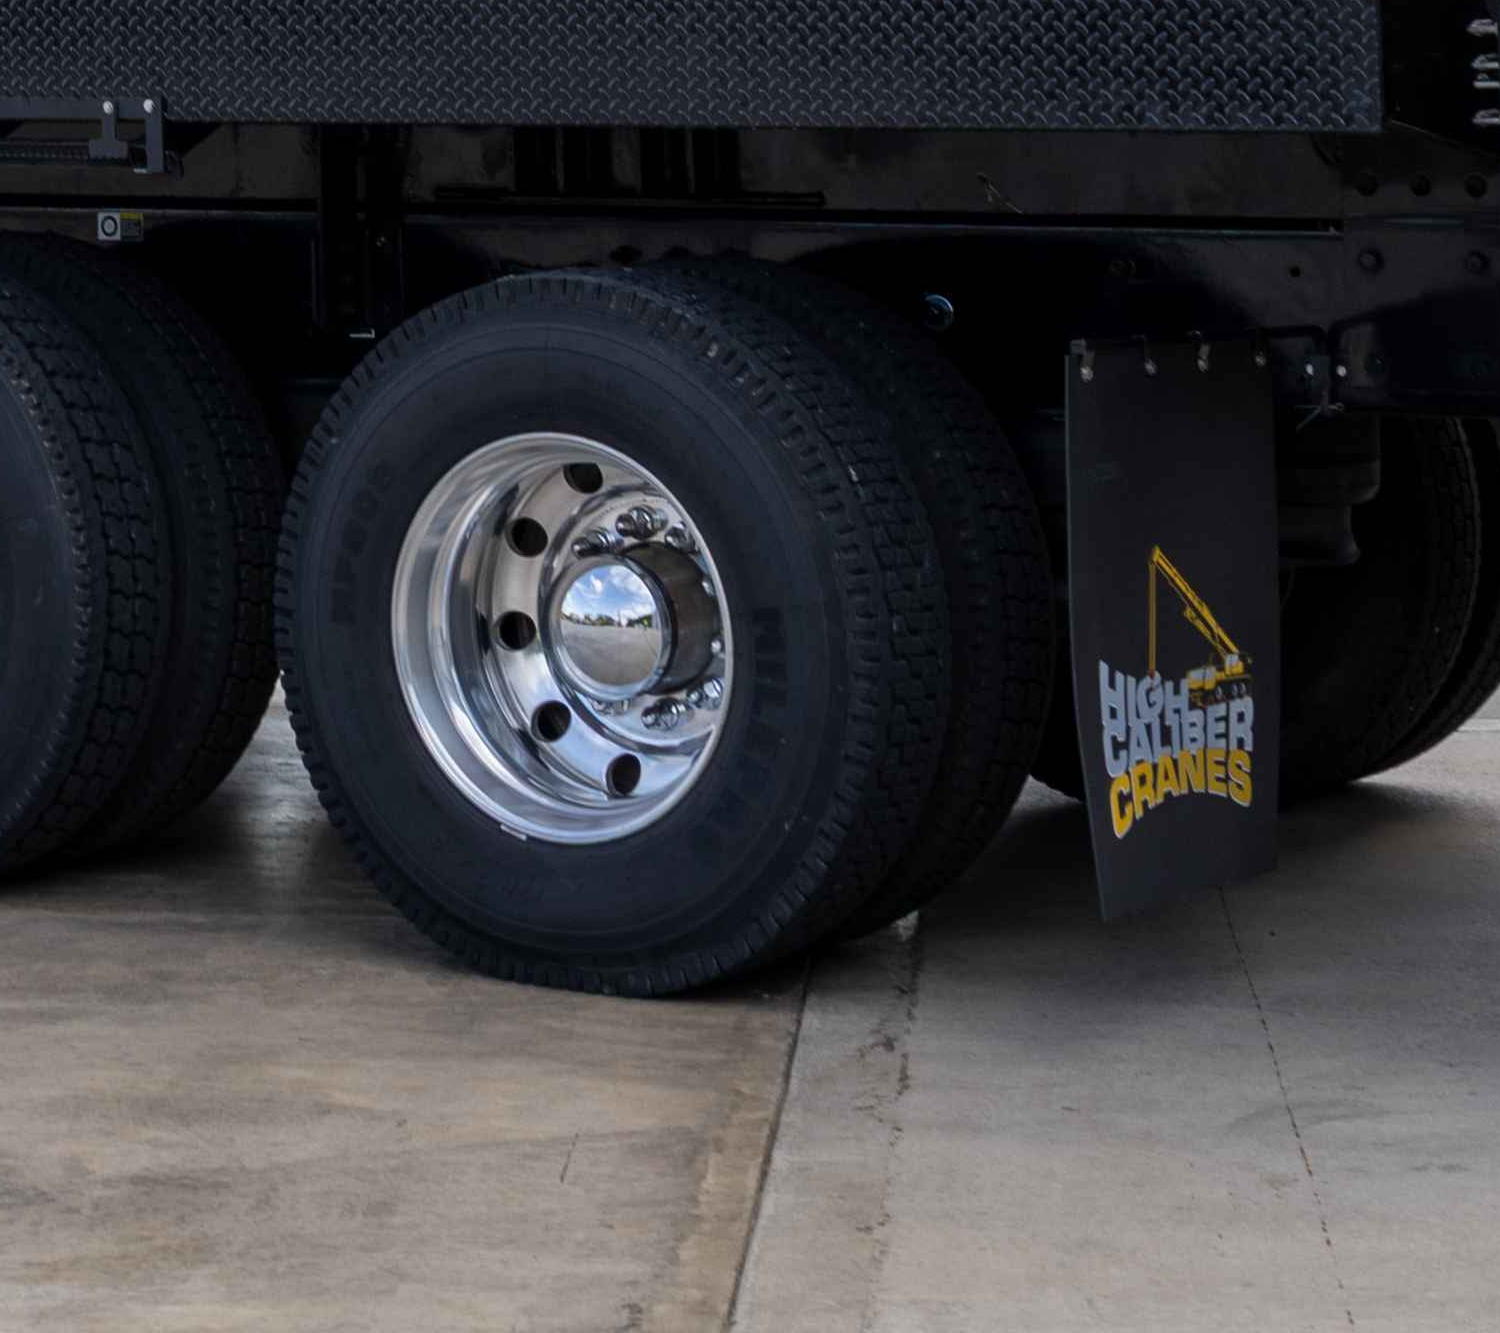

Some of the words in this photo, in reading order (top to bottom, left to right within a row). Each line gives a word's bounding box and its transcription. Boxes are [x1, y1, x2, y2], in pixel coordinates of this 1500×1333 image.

[1100, 659, 1189, 726] HIGH
[1102, 696, 1254, 779] CALIBER
[1110, 747, 1253, 840] CRANES
